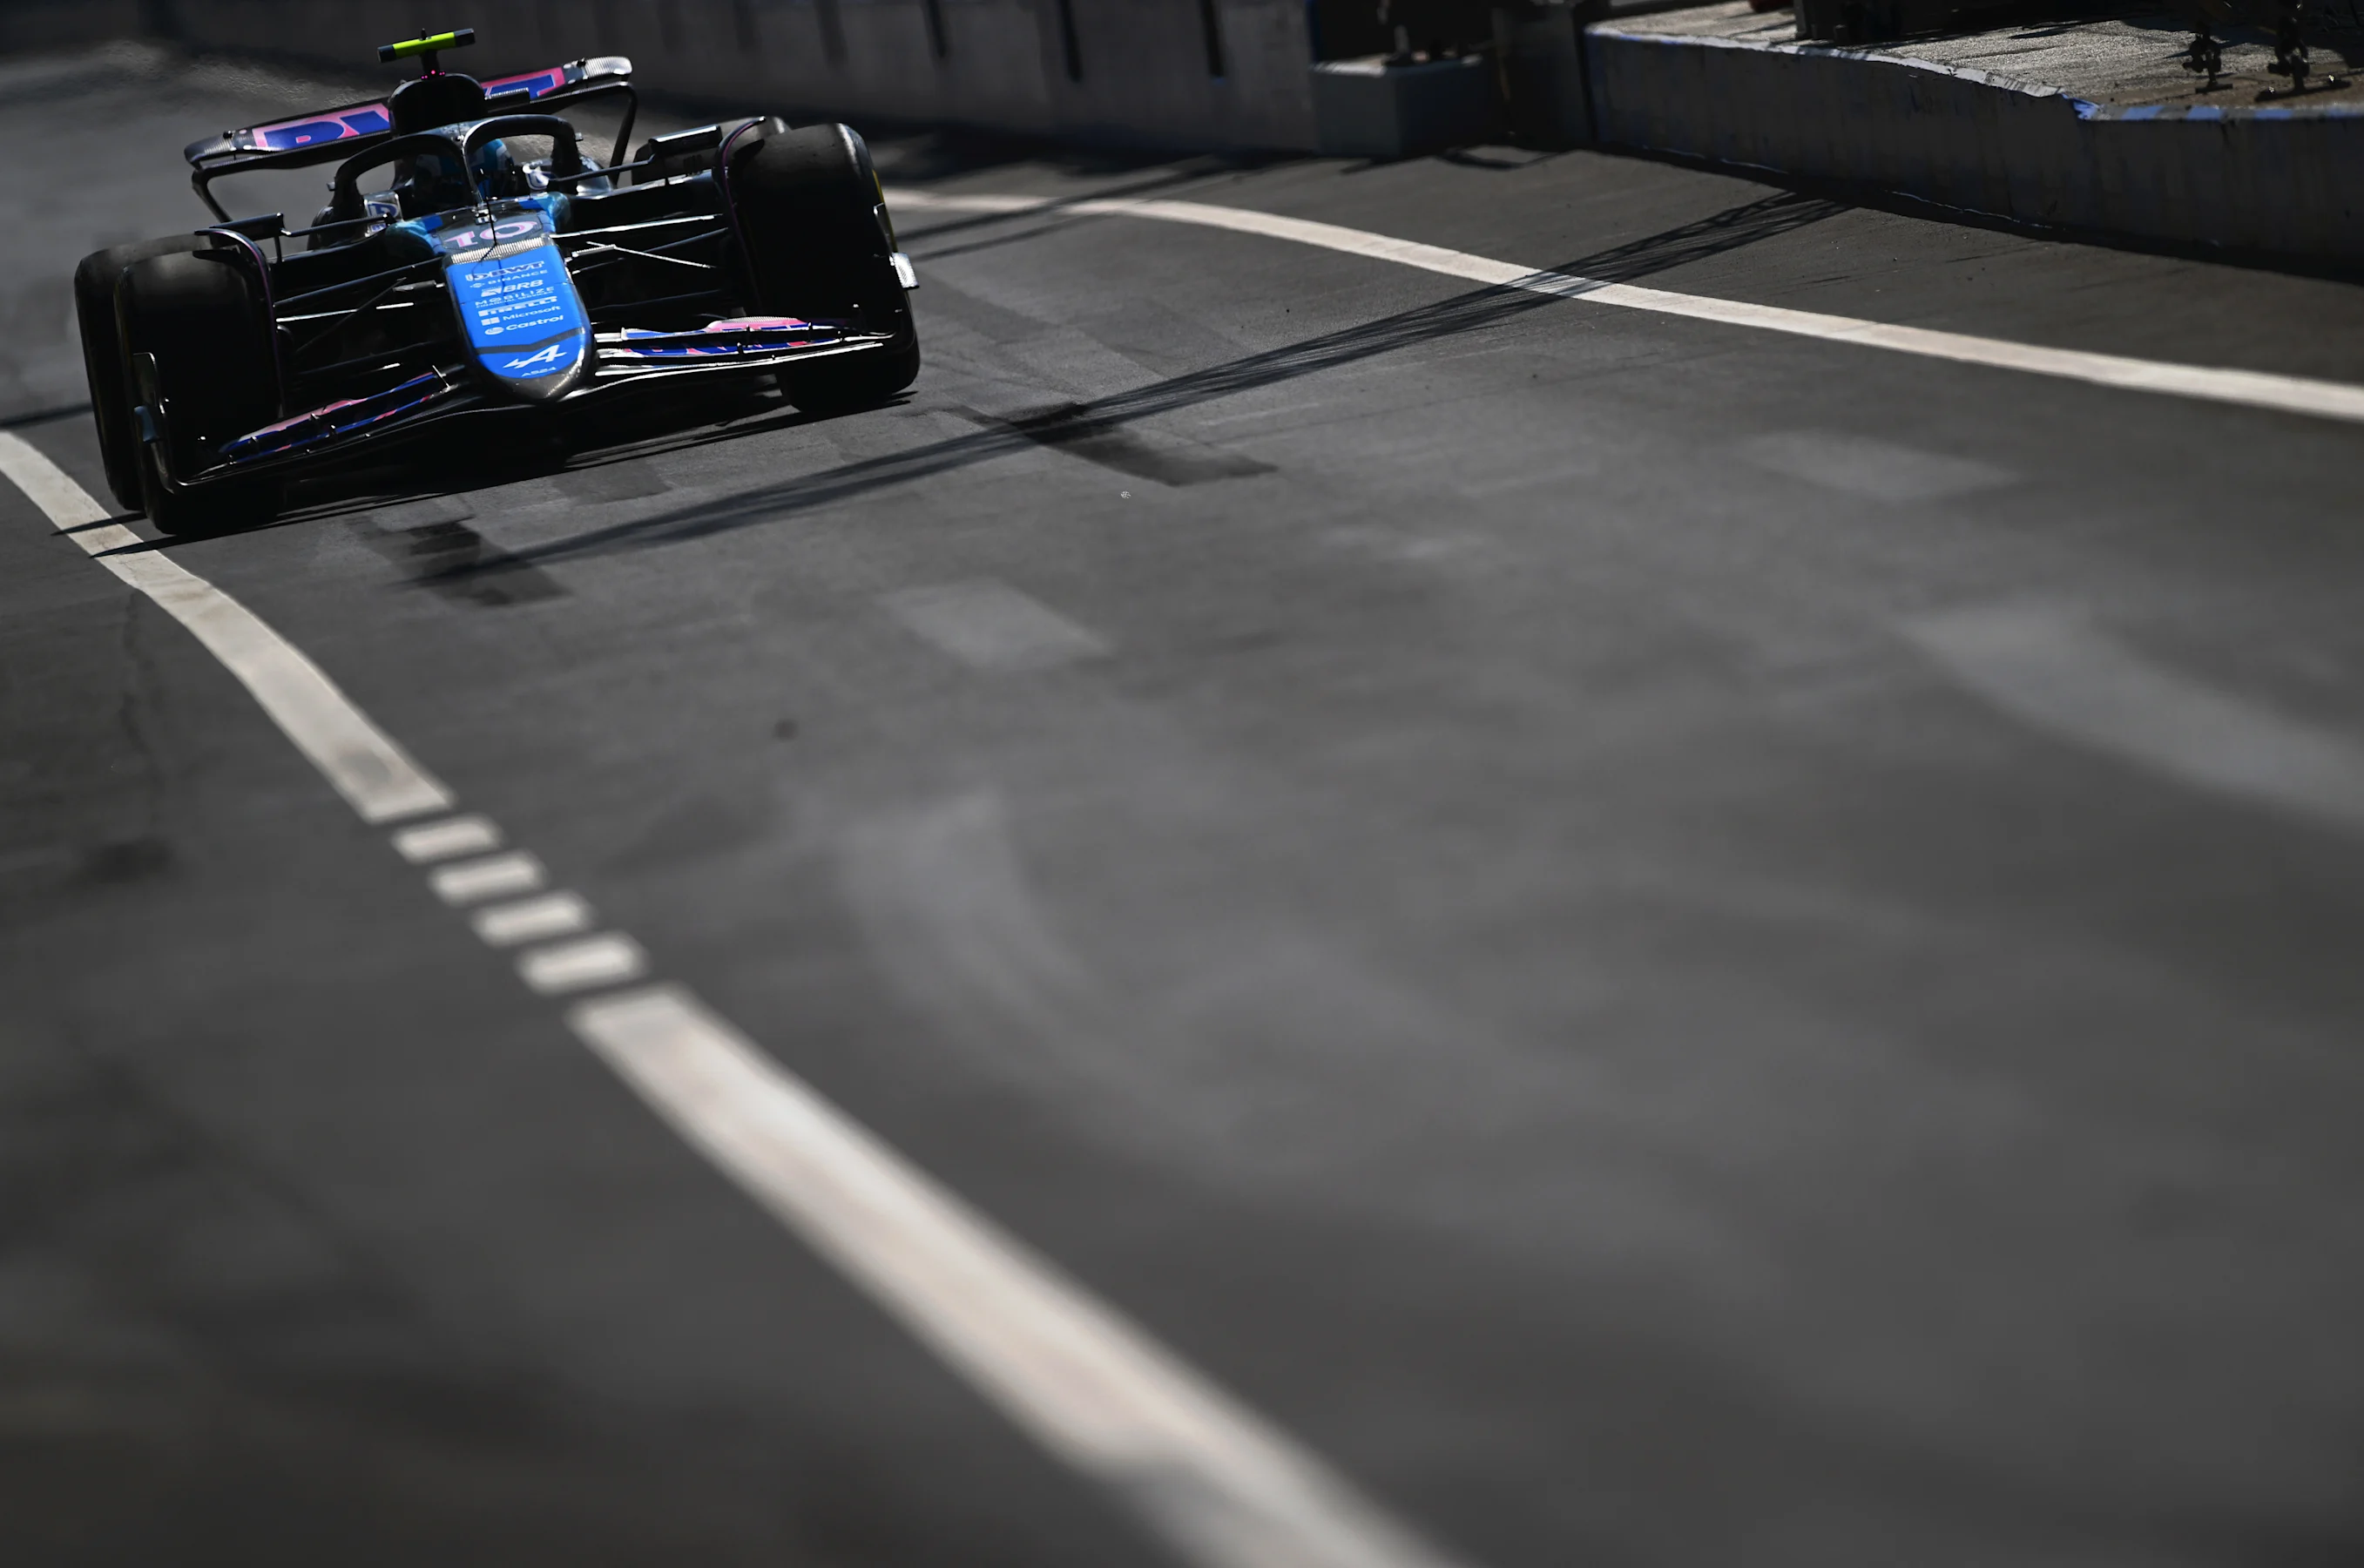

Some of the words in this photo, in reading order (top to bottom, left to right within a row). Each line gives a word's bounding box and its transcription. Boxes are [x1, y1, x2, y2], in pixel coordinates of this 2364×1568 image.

[443, 220, 537, 247] 10
[488, 269, 548, 285] BINANCE
[503, 279, 544, 293] BRB
[475, 286, 554, 307] MOBILIZE
[478, 295, 557, 317] PIRELLI
[503, 305, 561, 321] Microsoft
[506, 314, 564, 330] Castrol
[521, 366, 557, 377] A524
